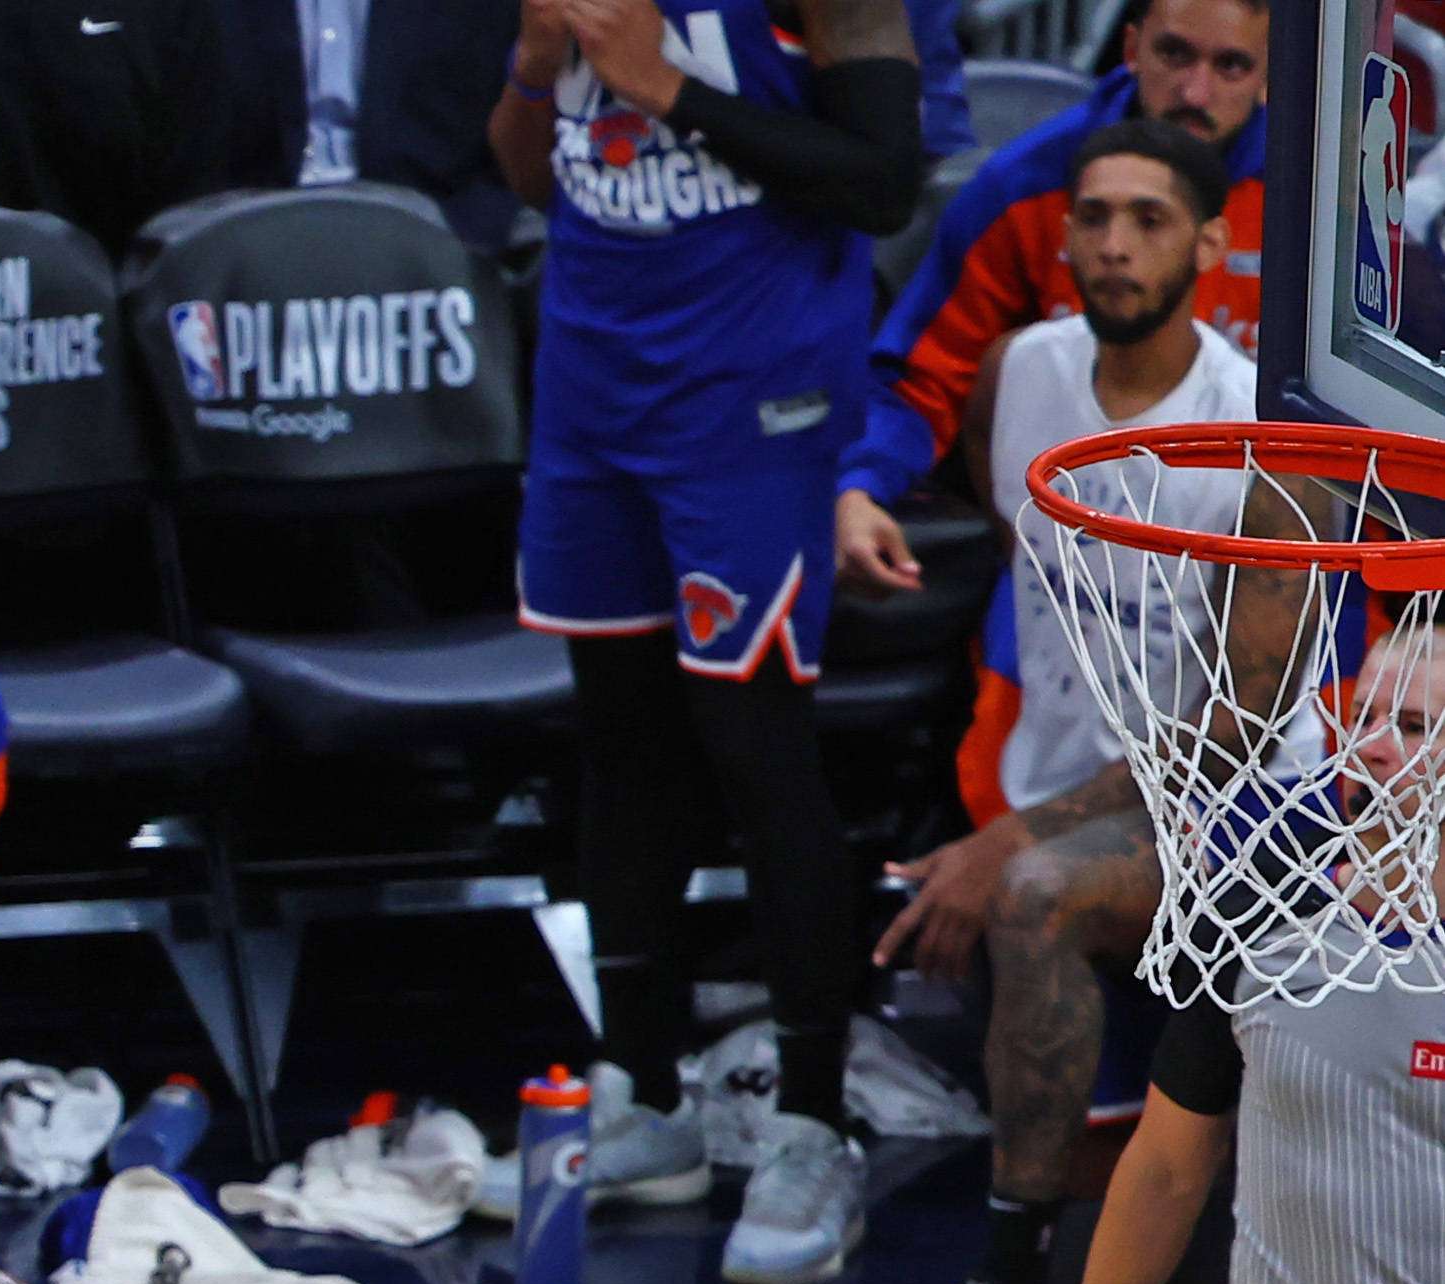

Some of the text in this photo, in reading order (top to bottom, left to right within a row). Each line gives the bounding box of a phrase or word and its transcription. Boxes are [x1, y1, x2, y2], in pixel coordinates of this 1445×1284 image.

[1359, 262, 1382, 312] NBA
[223, 286, 476, 399] PLAYOFFS
[250, 403, 354, 443] Google
